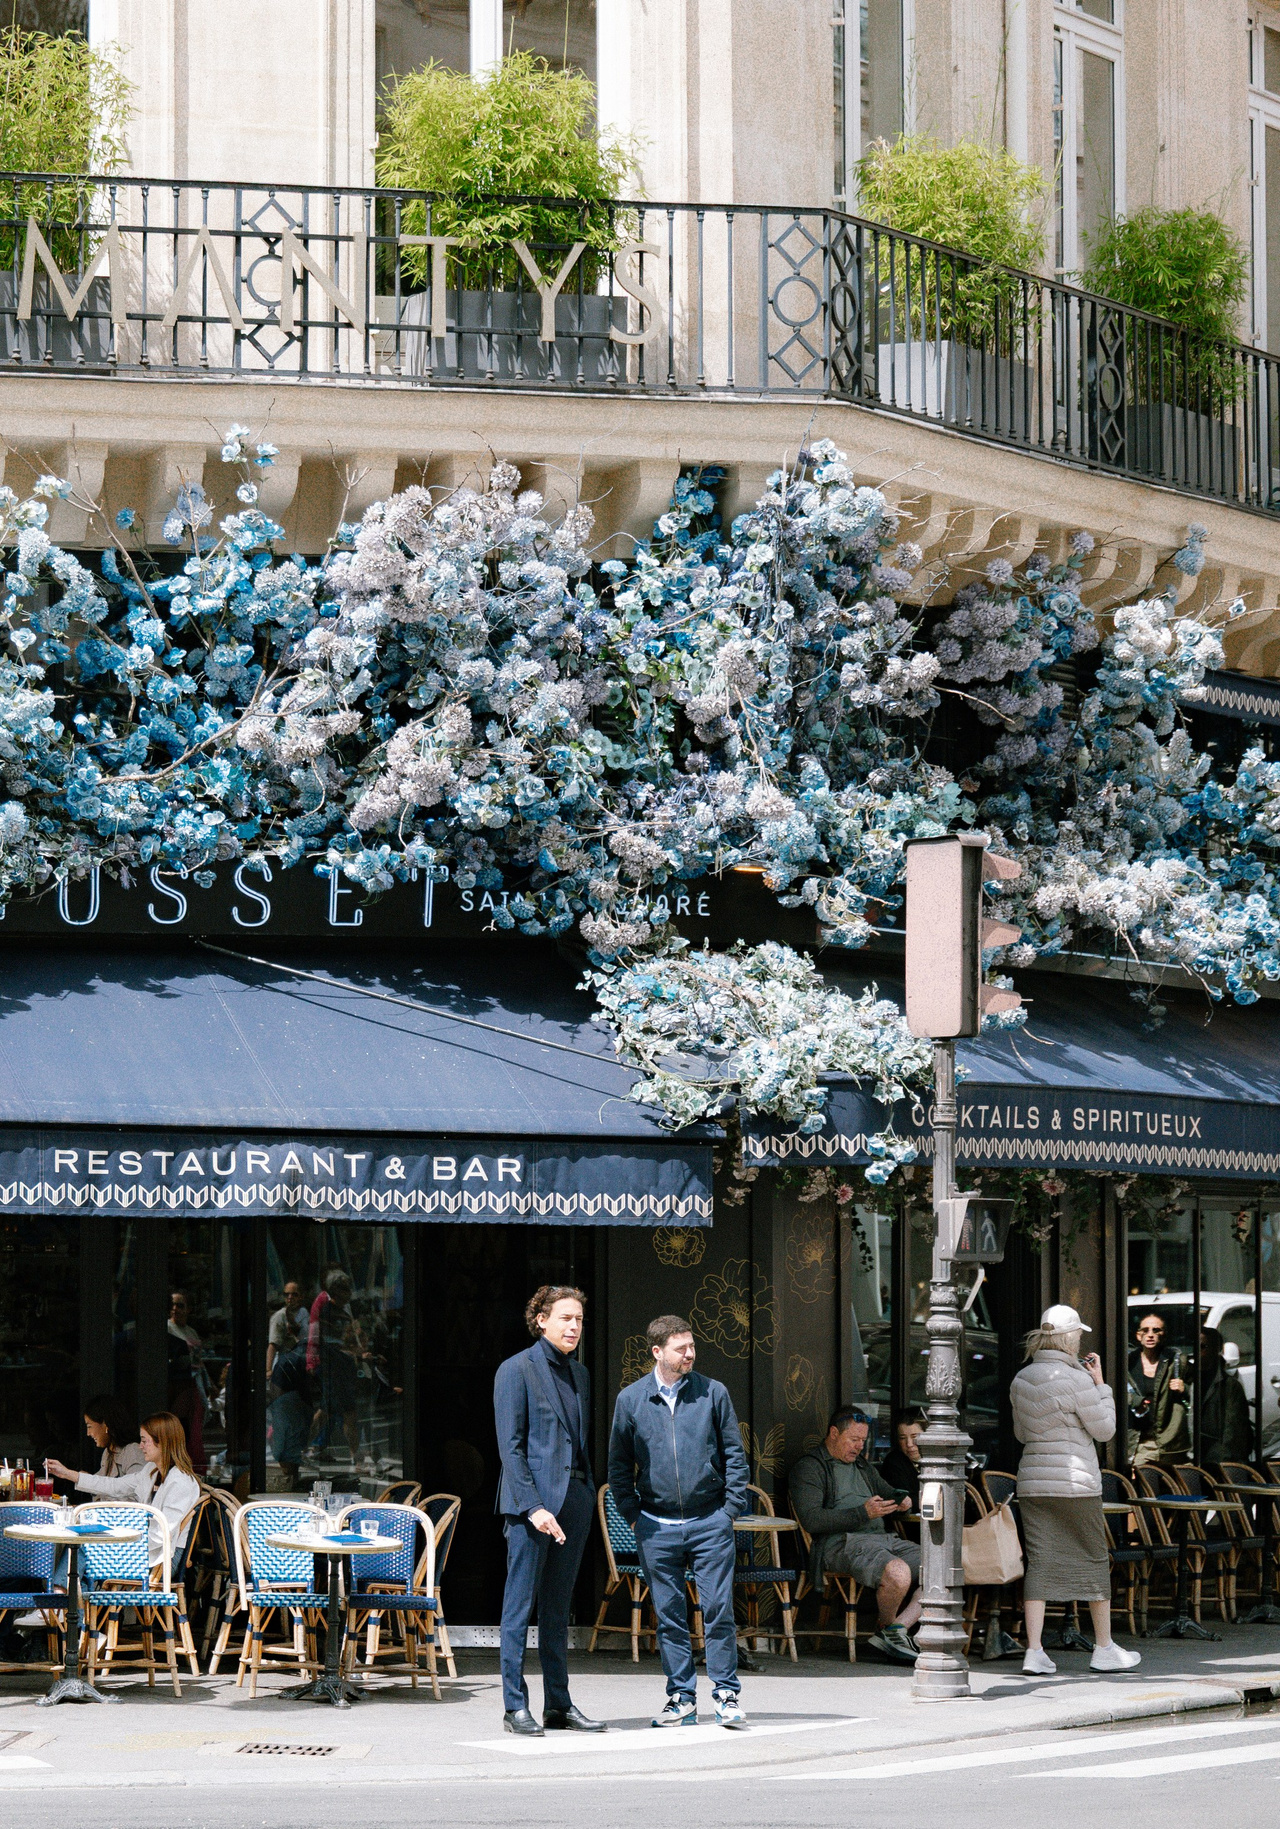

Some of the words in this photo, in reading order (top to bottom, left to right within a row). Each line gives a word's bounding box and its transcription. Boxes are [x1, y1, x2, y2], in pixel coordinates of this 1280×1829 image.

[1051, 1108, 1063, 1131] &
[1072, 1106, 1203, 1140] SPIRITUEUX
[54, 1148, 367, 1178] RESTAURANT
[384, 1158, 407, 1180] &
[432, 1155, 523, 1183] BAR
